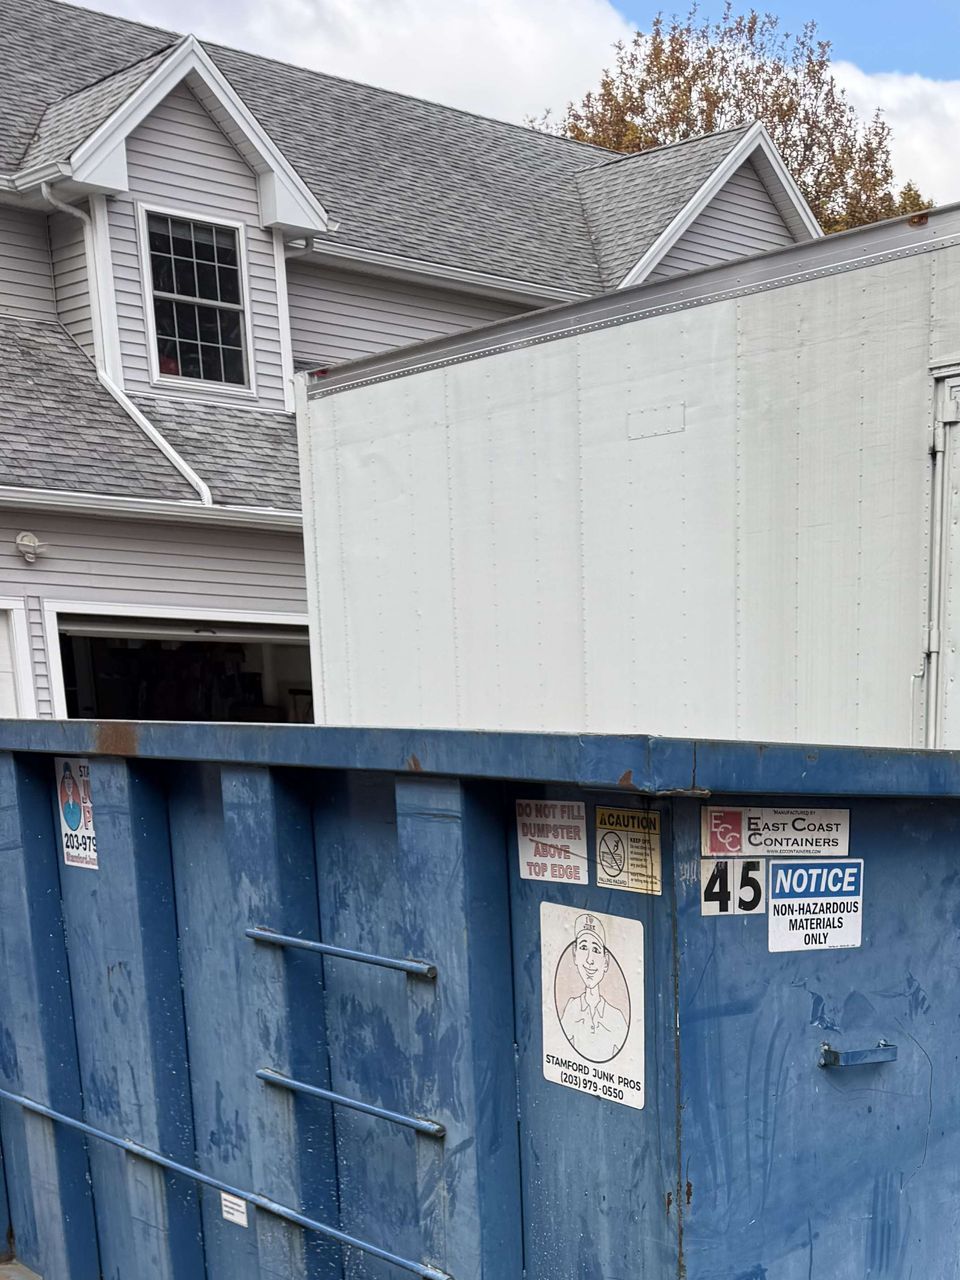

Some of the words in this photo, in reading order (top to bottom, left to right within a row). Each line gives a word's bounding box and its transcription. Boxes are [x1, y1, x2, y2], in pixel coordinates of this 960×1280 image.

[518, 802, 532, 818] DO
[536, 804, 557, 819] NOT
[560, 804, 585, 820] FILL
[607, 813, 657, 831] CAUTION
[747, 817, 788, 832] EAST
[791, 818, 841, 832] COAST
[521, 822, 581, 841] DUMPSTER
[747, 832, 839, 847] CONTAINERS
[533, 843, 571, 860] ABOVE
[526, 861, 548, 877] TOP
[551, 863, 581, 880] EDGE
[703, 860, 762, 913] 45
[775, 867, 857, 893] NOTICE
[773, 901, 859, 917] NON-HAZARDOUS
[788, 917, 844, 931] MATERIALS
[804, 932, 829, 945] ONLY
[546, 1054, 589, 1077] STAMFORD
[592, 1068, 615, 1084] JUNK
[617, 1076, 641, 1092] PROS
[561, 1071, 581, 1088] (203)
[582, 1077, 624, 1100] 979-0550
